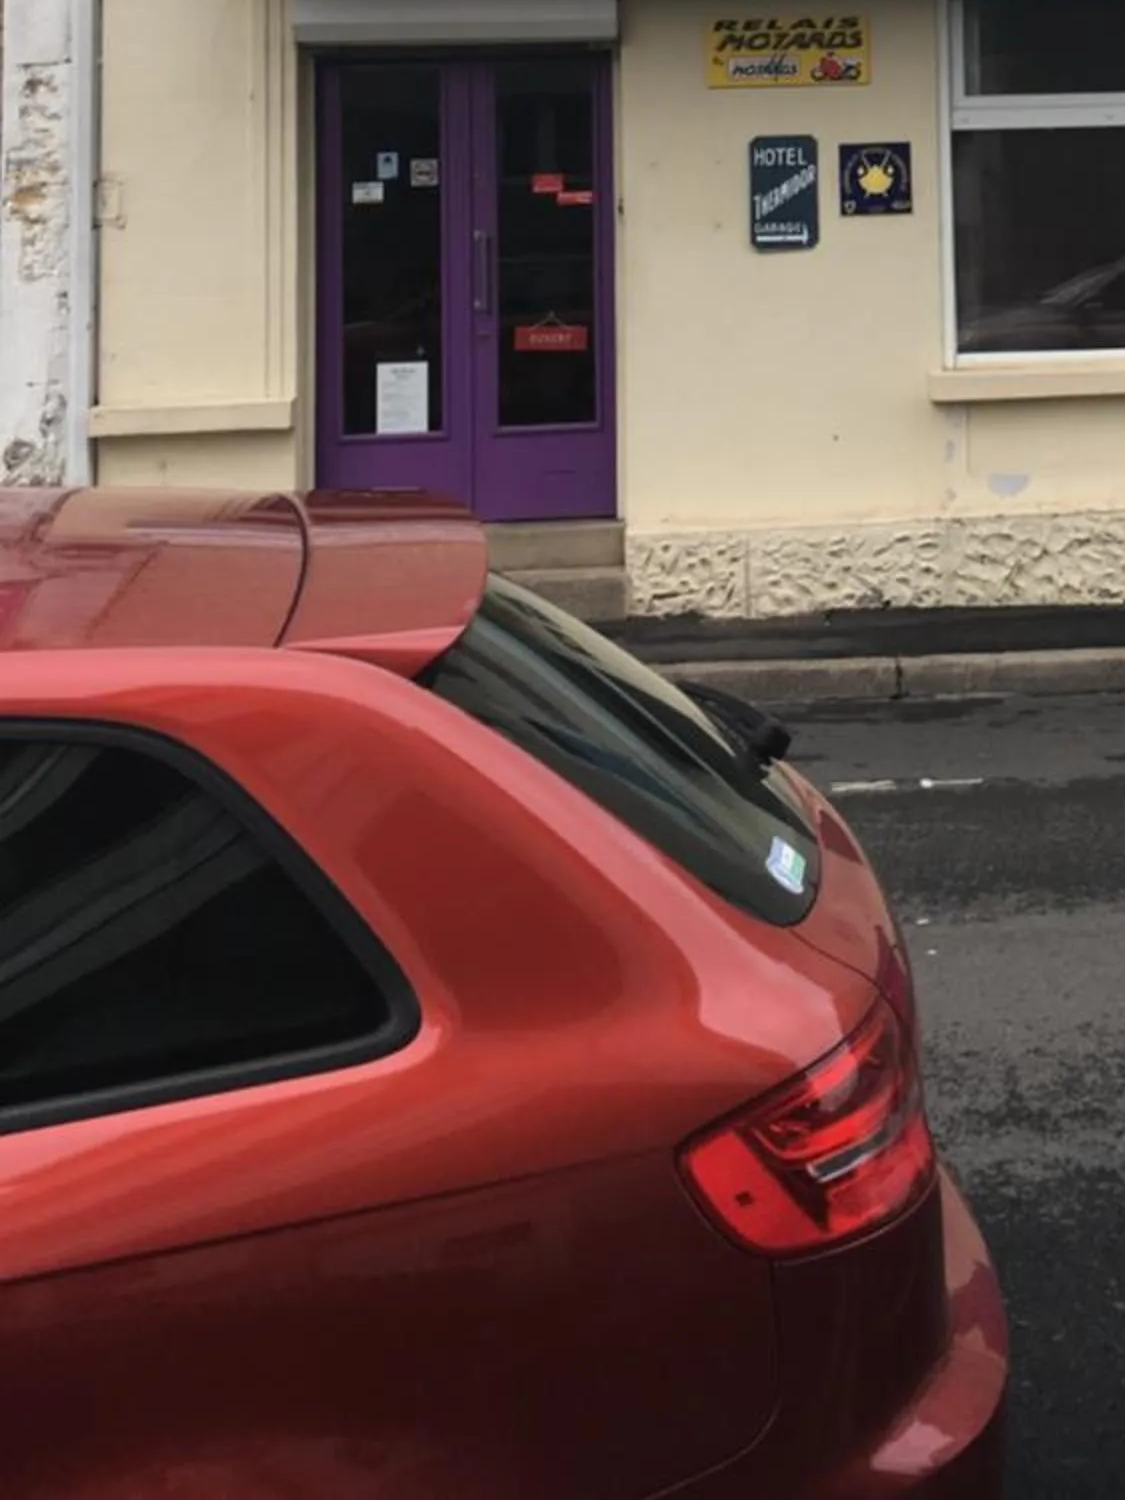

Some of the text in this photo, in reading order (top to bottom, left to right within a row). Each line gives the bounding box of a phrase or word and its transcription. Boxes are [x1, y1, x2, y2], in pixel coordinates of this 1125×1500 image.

[713, 16, 860, 32] RELAIS
[716, 30, 864, 52] MOTARDS
[753, 148, 808, 166] HOTEL
